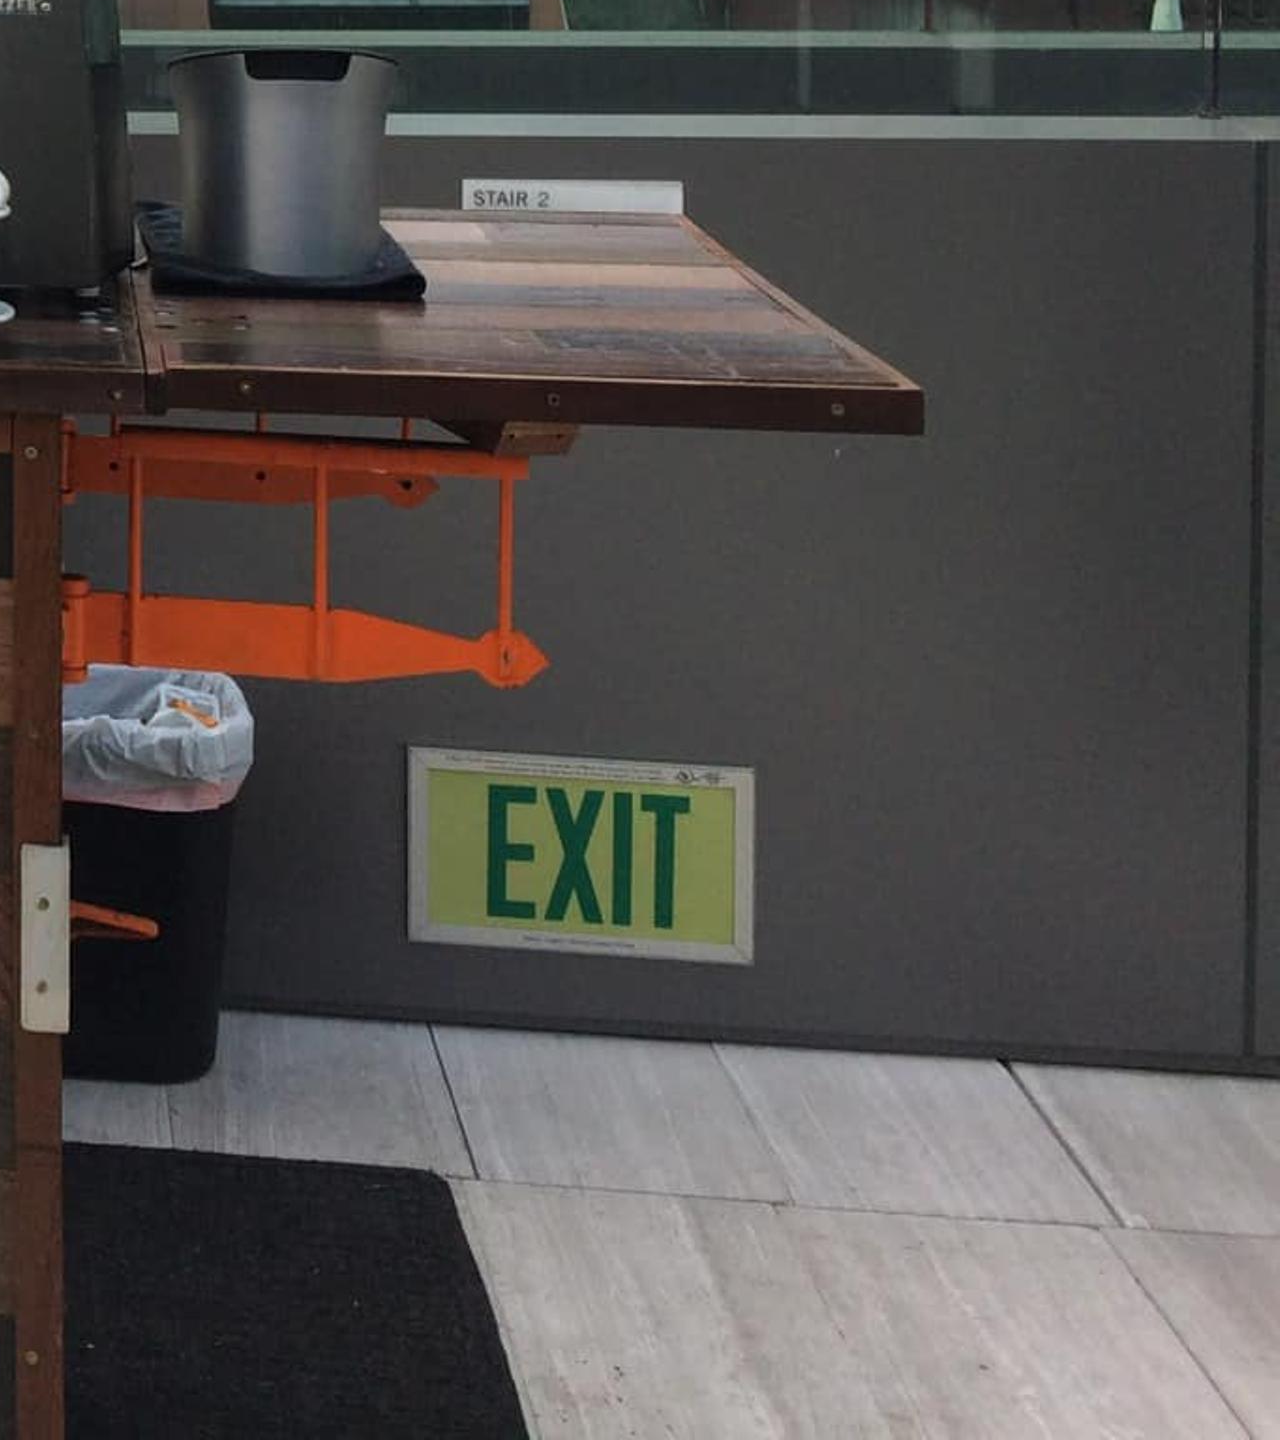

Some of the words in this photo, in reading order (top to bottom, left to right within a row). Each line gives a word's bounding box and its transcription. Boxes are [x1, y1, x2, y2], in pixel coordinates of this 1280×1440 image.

[473, 189, 528, 207] STAIR
[537, 191, 550, 208] 2
[486, 784, 691, 929] EXIT
